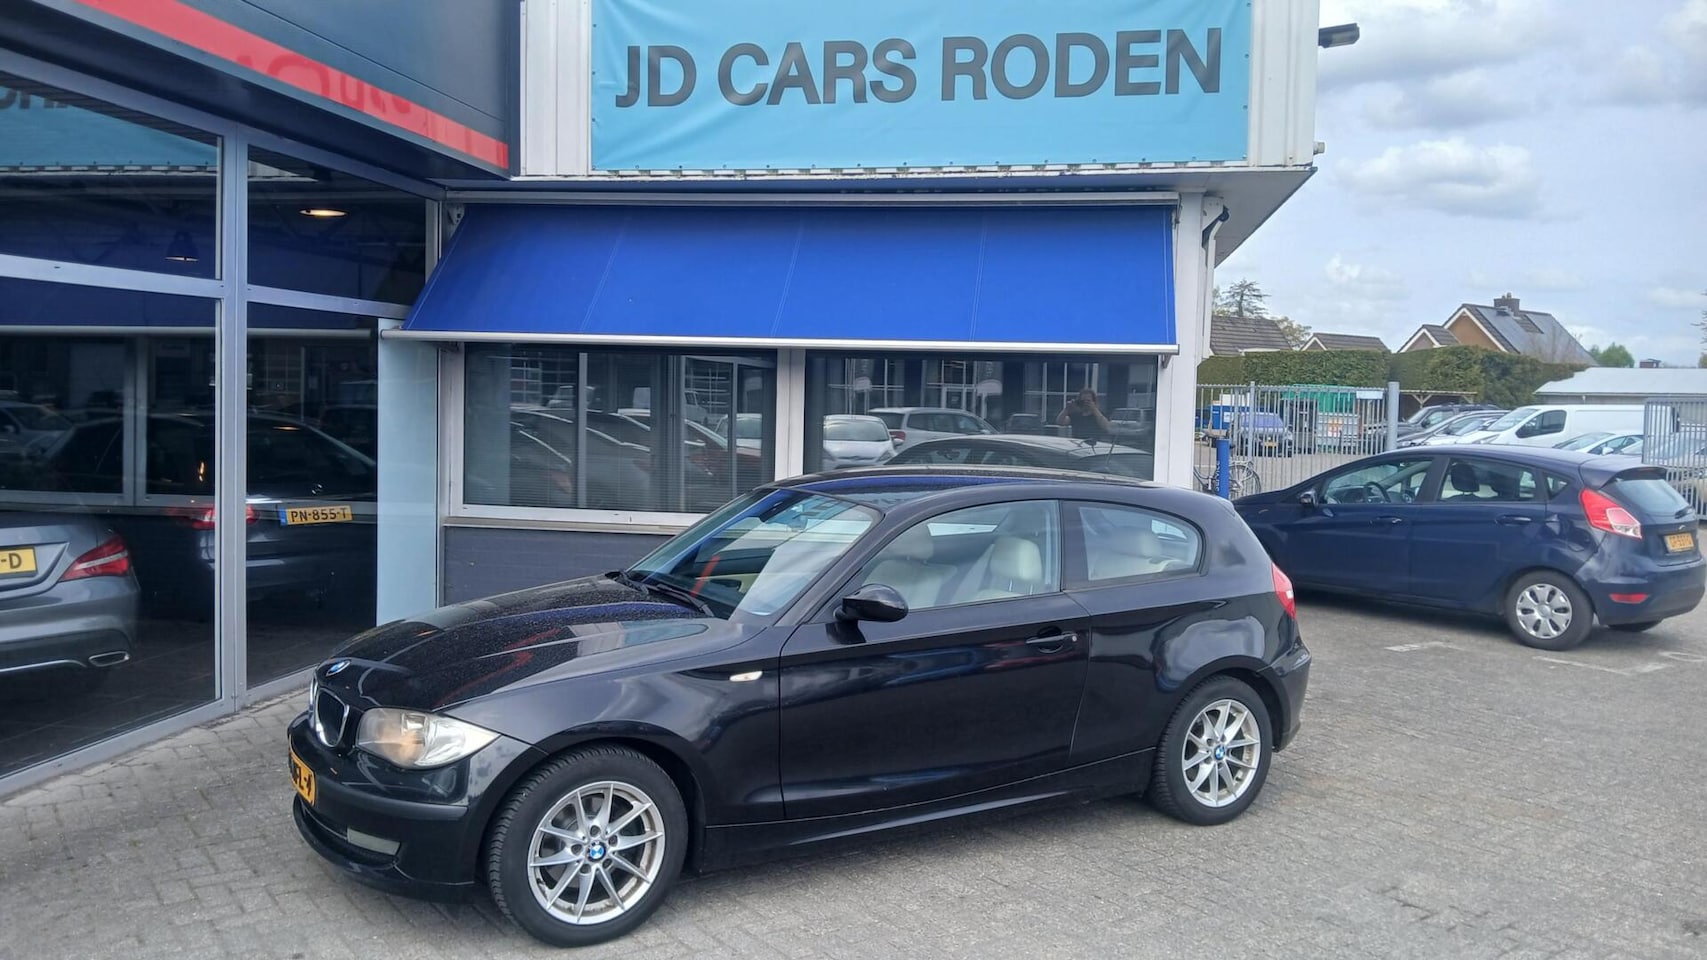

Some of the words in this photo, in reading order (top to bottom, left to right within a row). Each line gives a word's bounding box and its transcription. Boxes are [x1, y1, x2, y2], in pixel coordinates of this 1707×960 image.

[616, 46, 697, 107] JD
[717, 40, 917, 106] CARS
[941, 28, 1221, 101] RODEN
[291, 507, 347, 522] PN-855-T
